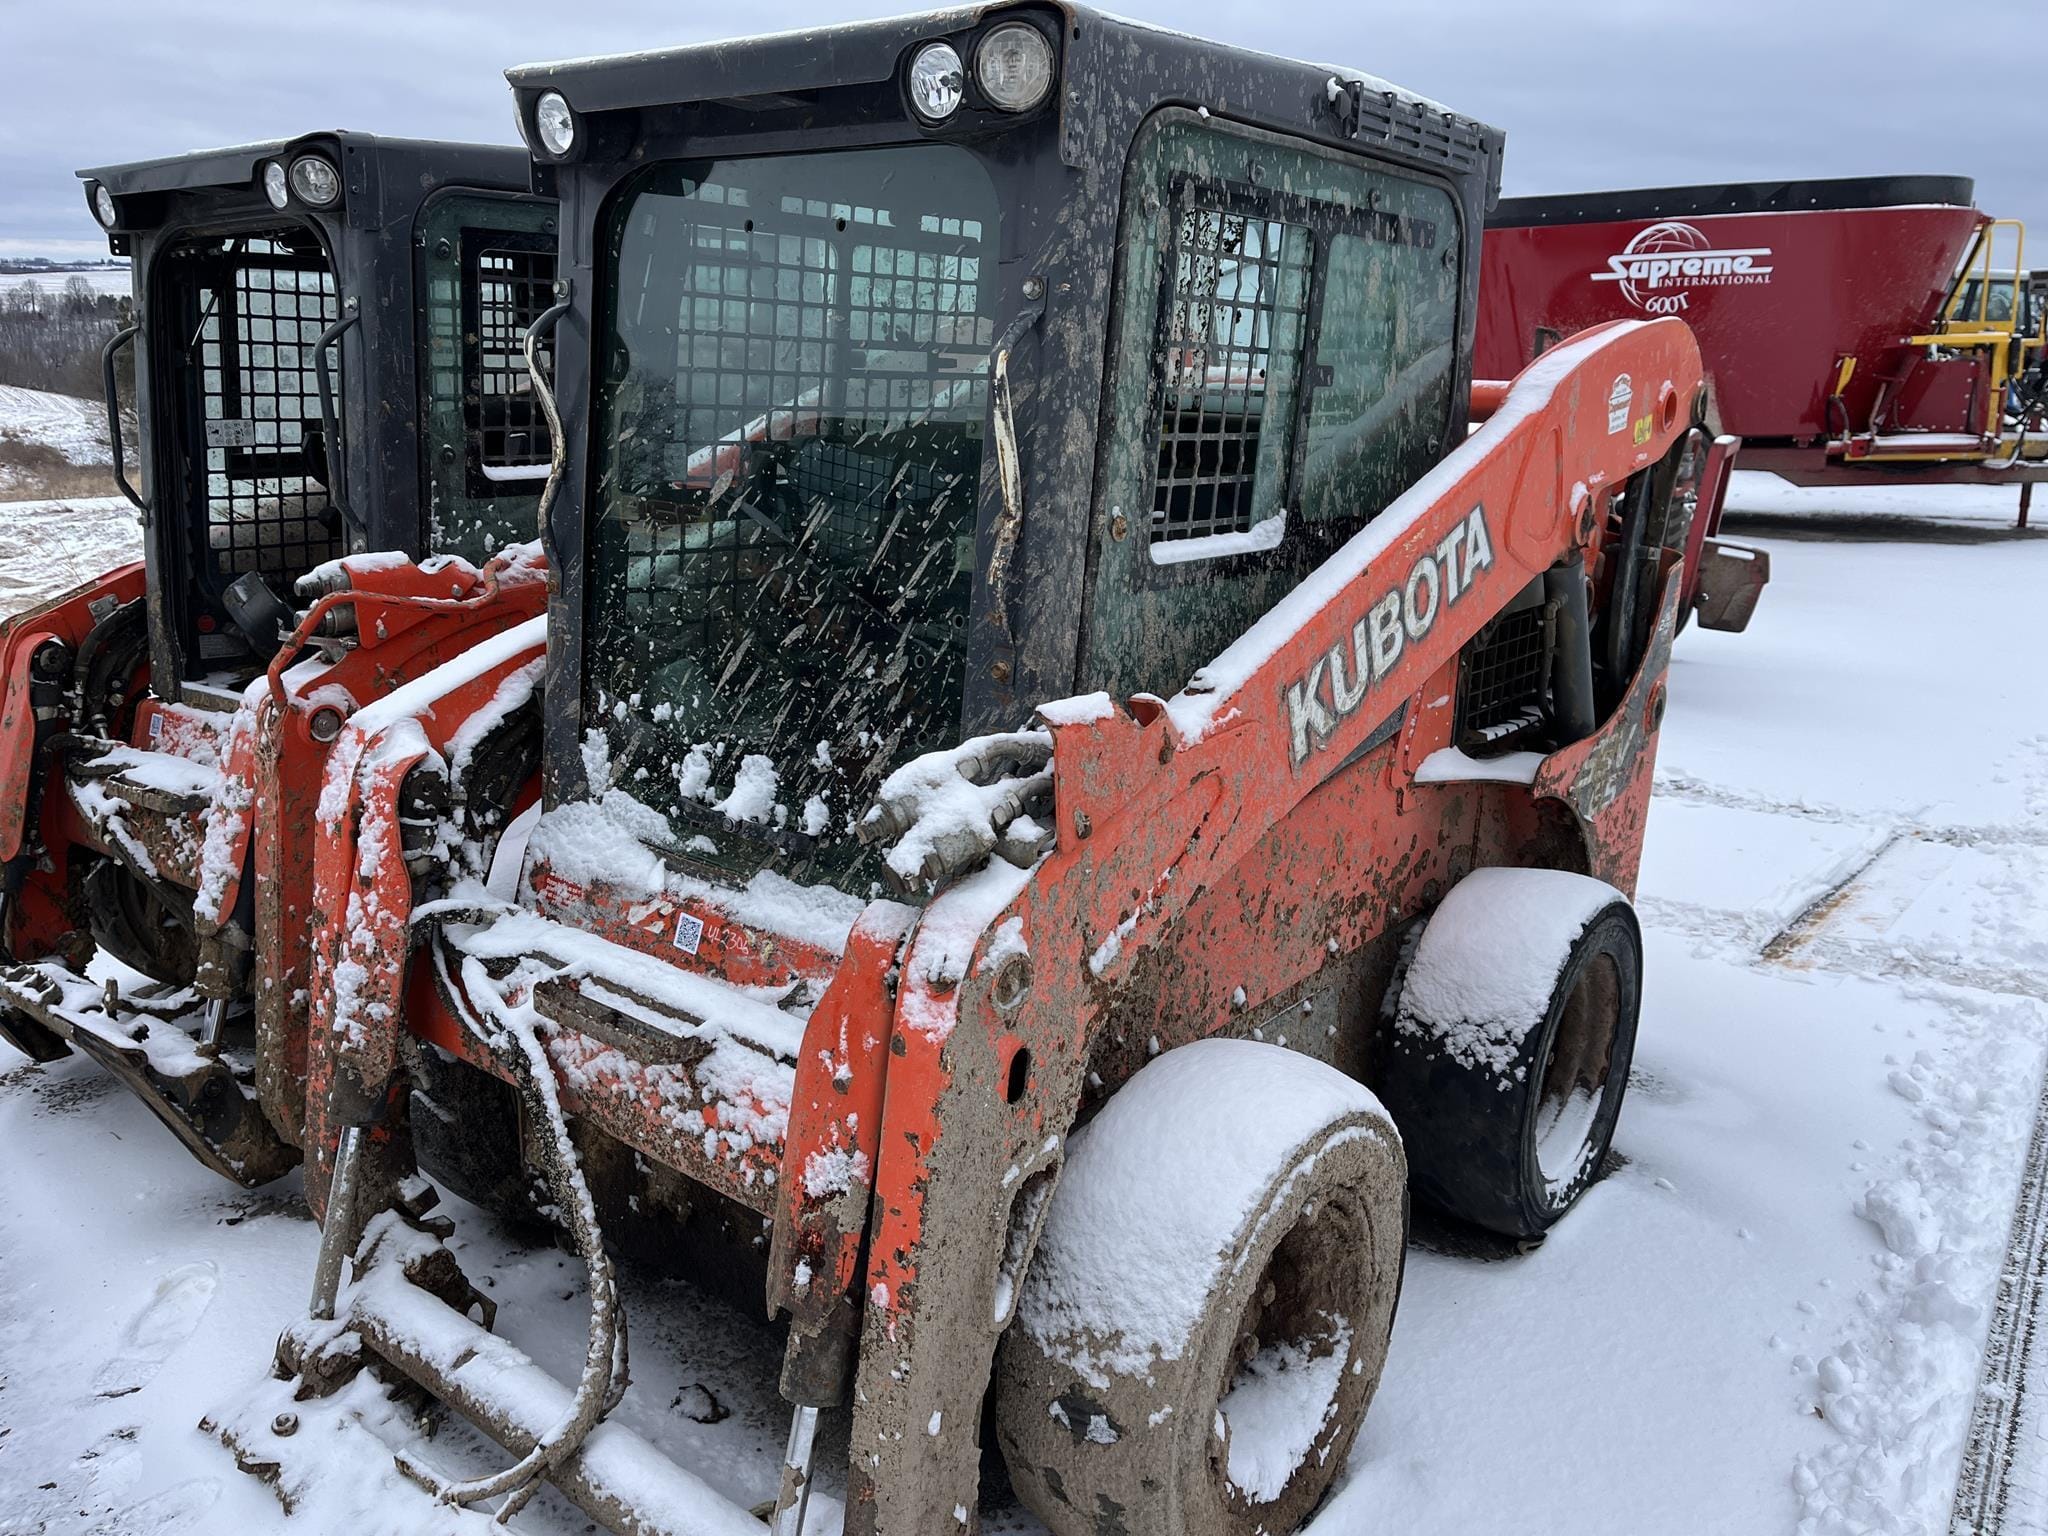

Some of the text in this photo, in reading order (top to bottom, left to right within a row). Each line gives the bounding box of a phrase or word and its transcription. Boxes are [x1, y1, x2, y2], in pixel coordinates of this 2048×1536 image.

[1590, 248, 1773, 289] Supreme
[1658, 275, 1772, 288] INTERNATIONAL
[1645, 292, 1690, 313] 600T
[1287, 504, 1492, 763] KUBOTA
